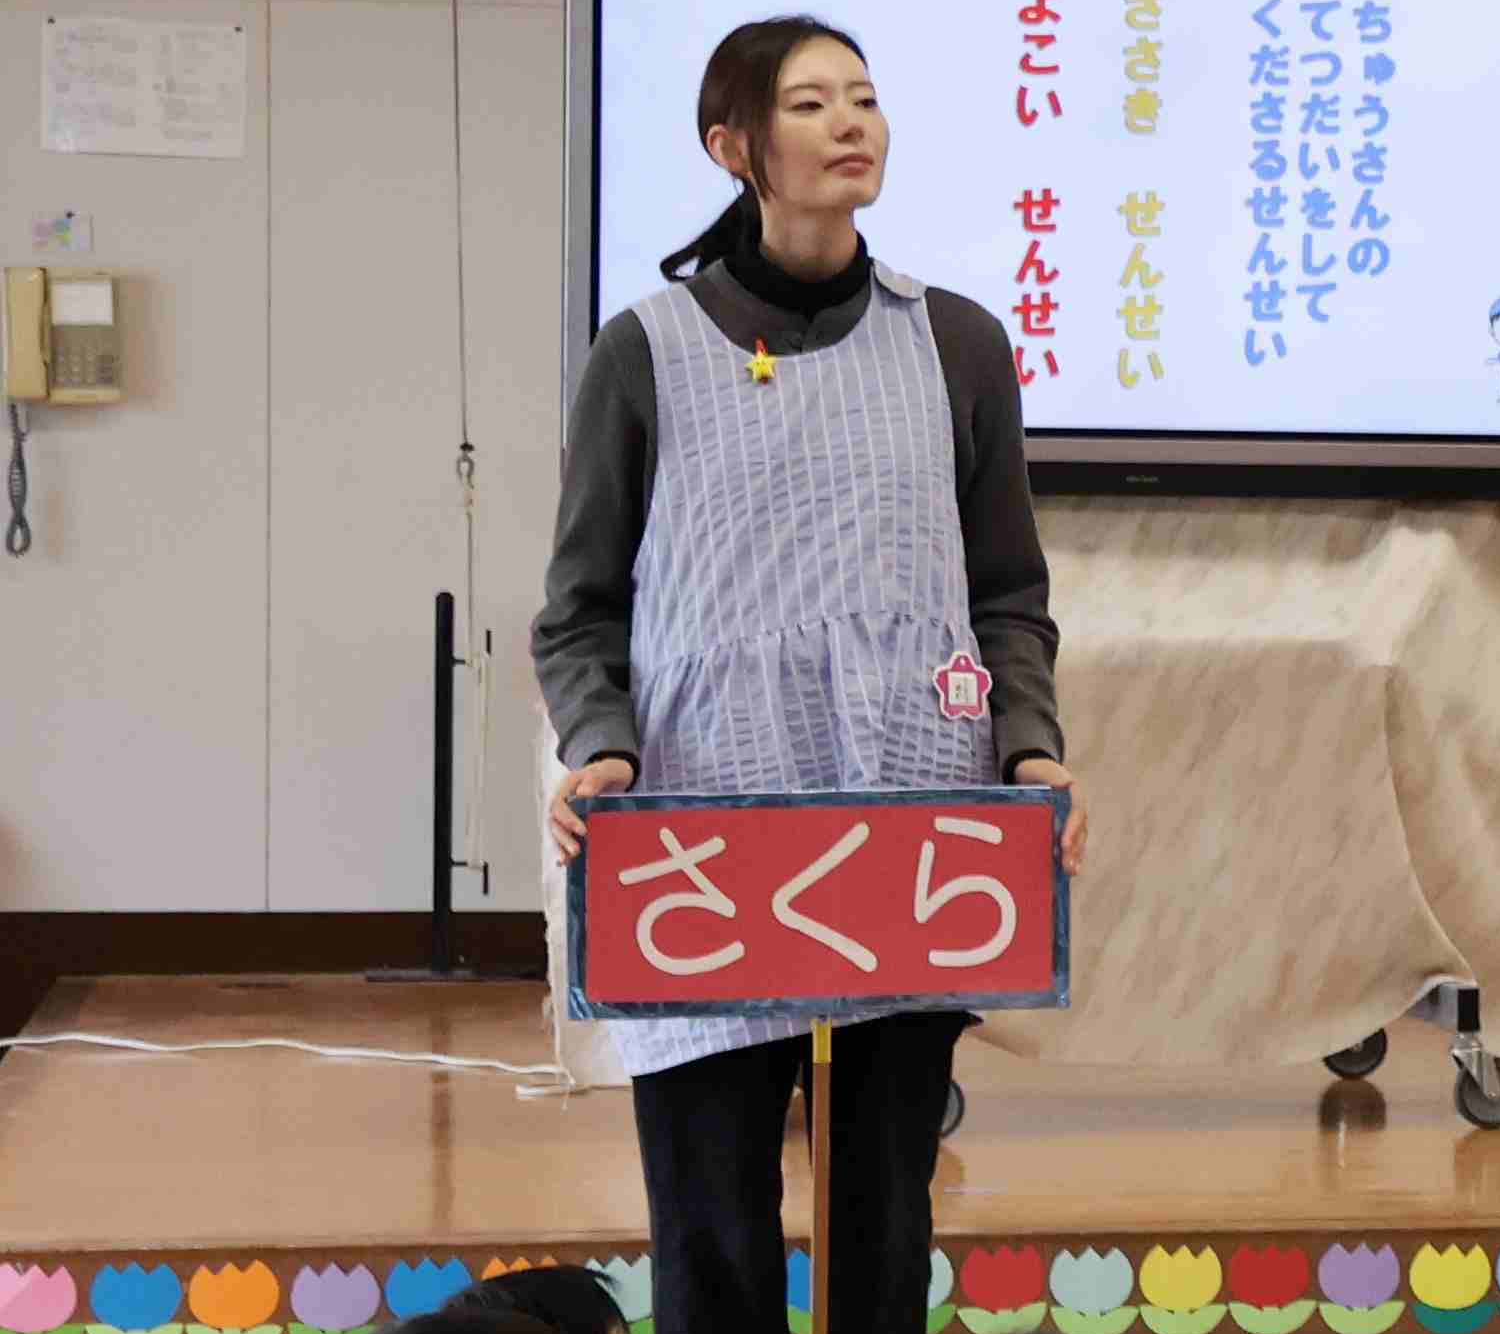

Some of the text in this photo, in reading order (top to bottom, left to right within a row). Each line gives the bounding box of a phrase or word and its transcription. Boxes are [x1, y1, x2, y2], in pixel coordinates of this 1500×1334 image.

[1012, 188, 1060, 386] せんせい
[1117, 190, 1165, 389] せんせい
[618, 816, 1018, 976] さくら
